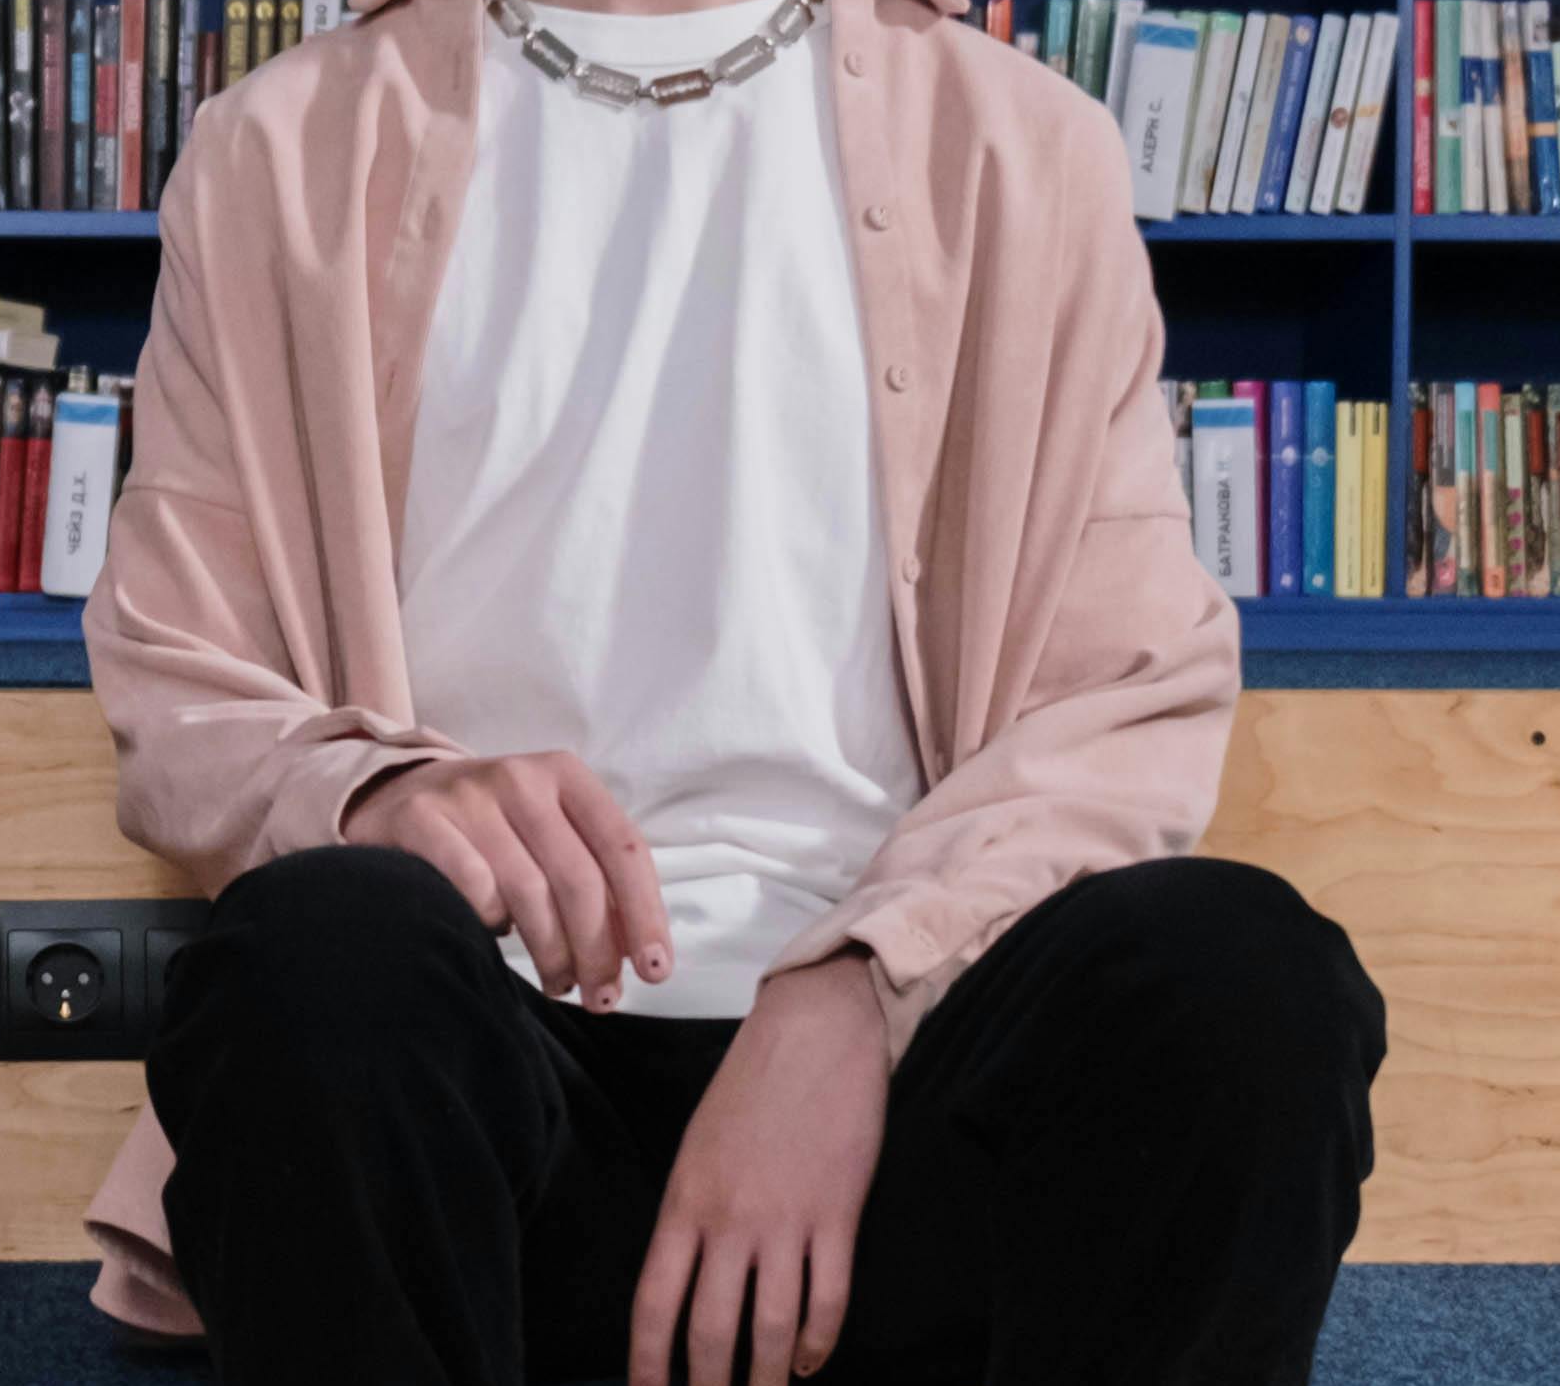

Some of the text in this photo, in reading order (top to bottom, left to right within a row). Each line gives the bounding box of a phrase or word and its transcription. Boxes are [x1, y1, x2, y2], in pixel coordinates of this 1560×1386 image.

[1141, 117, 1161, 174] АХЕРН
[66, 510, 84, 555] ЧЕЙЗ
[1216, 478, 1233, 578] БАТРАКОВА
